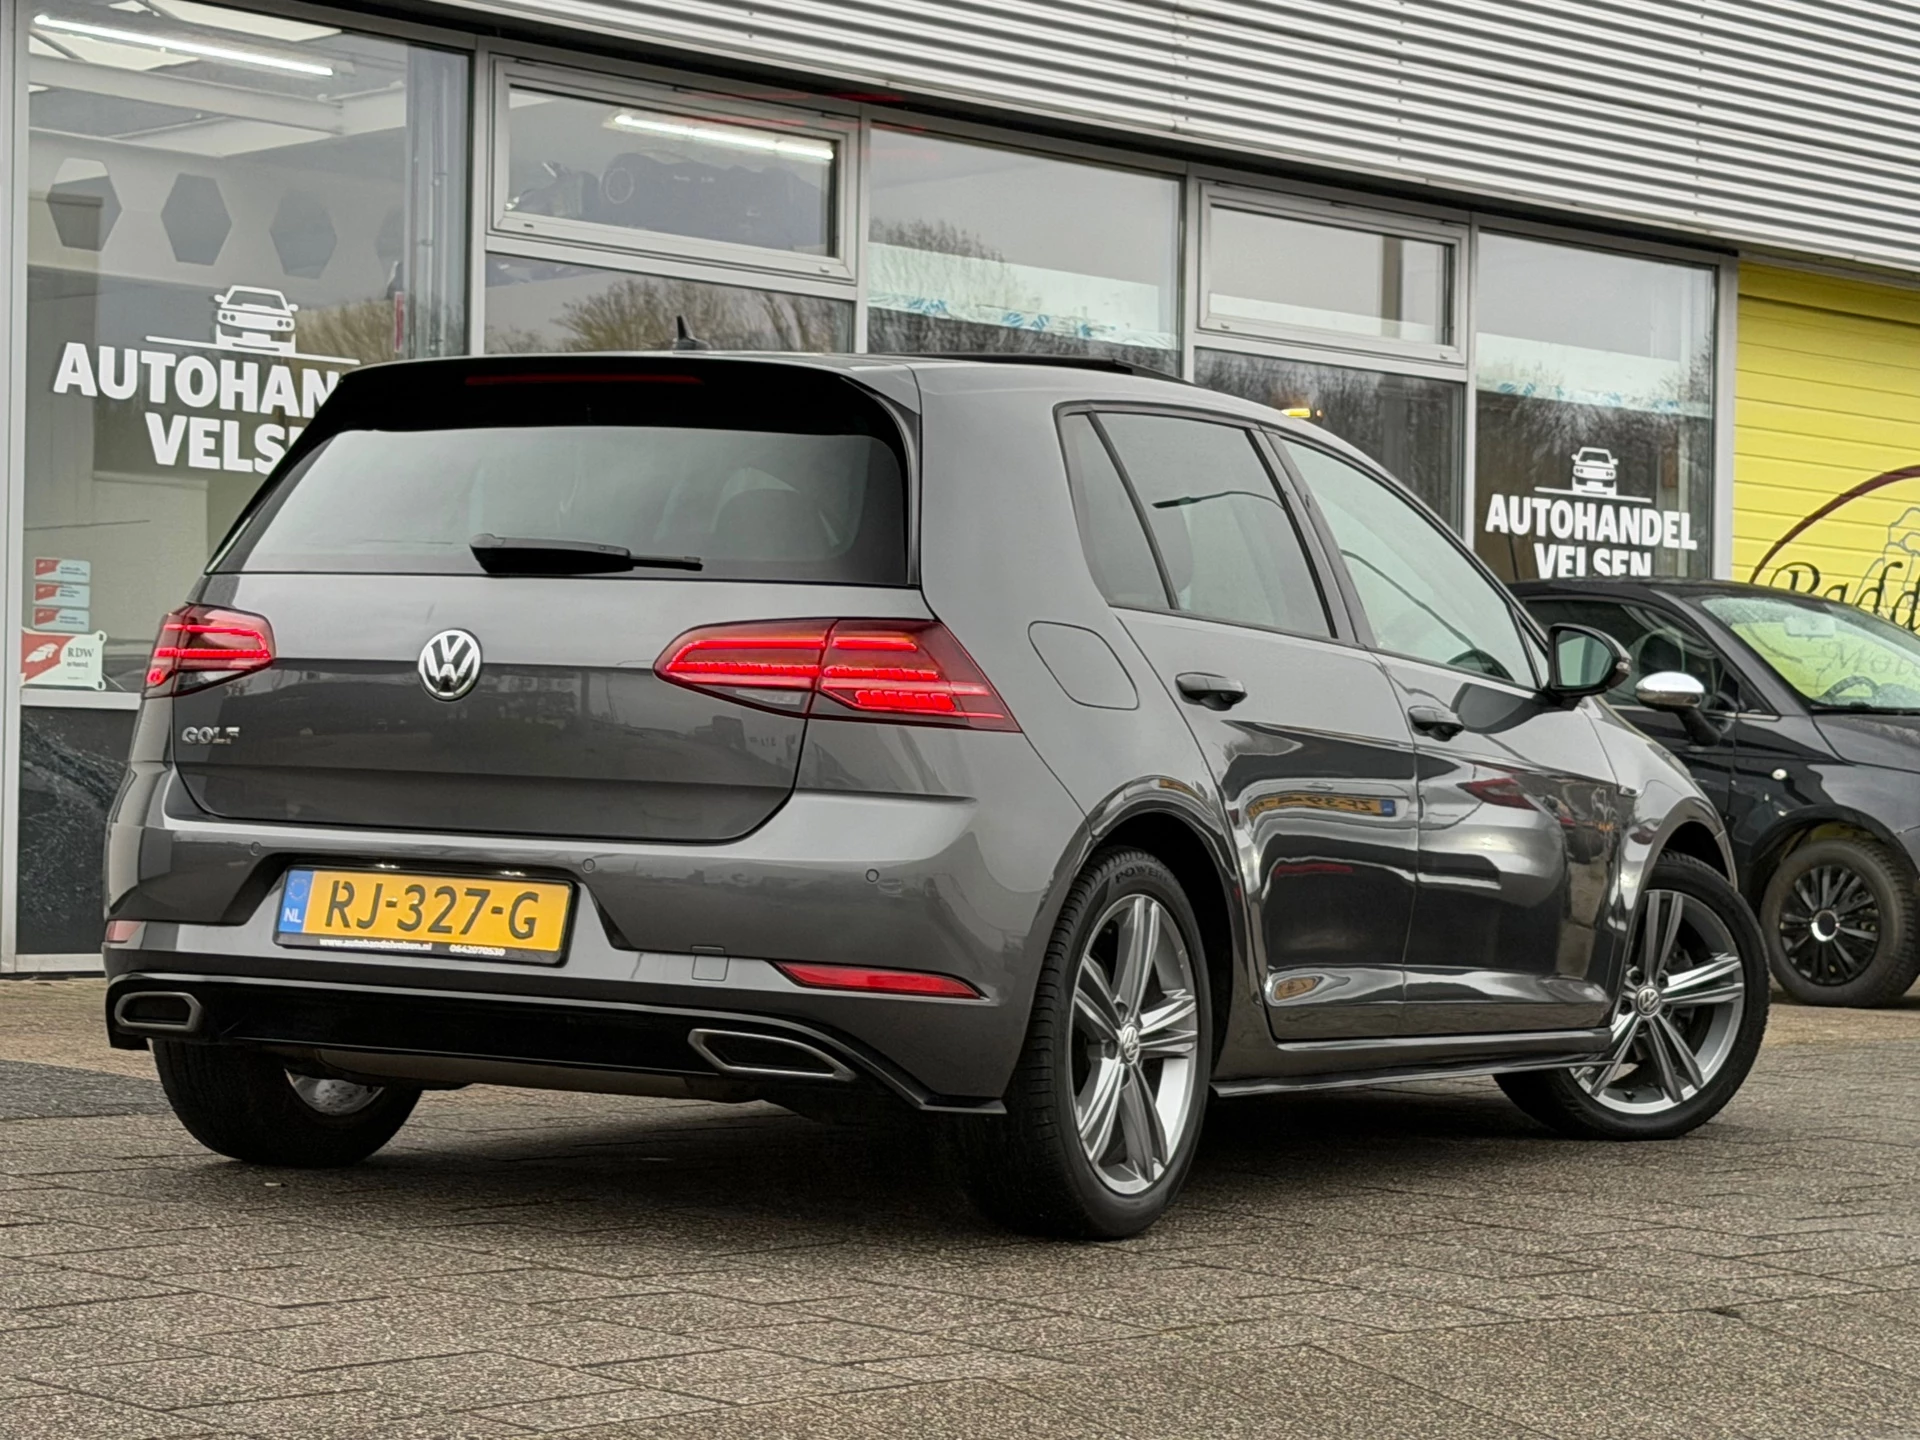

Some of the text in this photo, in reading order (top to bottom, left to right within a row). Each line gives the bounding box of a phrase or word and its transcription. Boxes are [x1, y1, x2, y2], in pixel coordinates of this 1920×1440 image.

[53, 342, 339, 419] AUTOHAN
[145, 412, 303, 476] VELS
[1485, 494, 1698, 550] AUTOHANDEL
[67, 647, 94, 657] RDW
[181, 726, 240, 745] GOLF
[283, 907, 302, 923] NL
[325, 879, 540, 940] RJ-327-G
